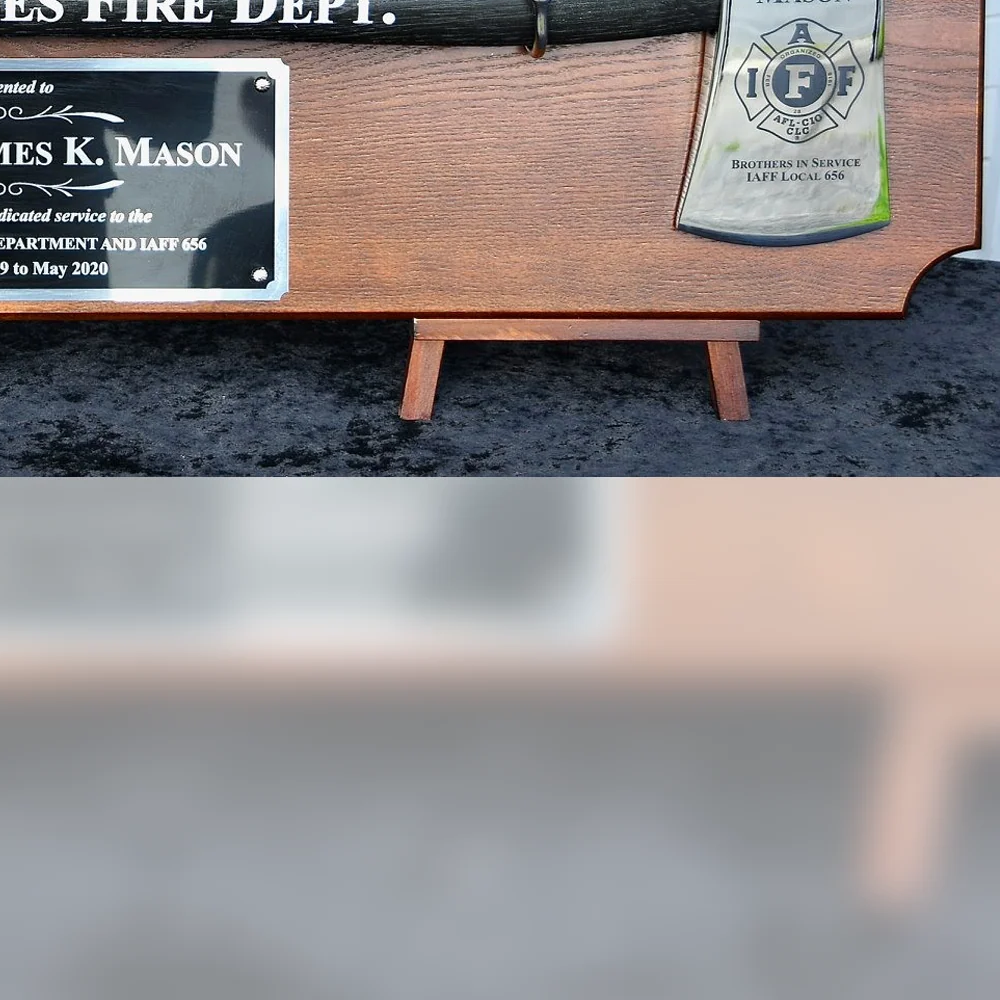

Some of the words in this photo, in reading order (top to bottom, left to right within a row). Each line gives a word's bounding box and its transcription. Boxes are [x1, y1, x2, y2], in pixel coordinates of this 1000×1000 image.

[780, 48, 822, 60] ORGANIZED
[38, 80, 55, 95] to
[773, 114, 823, 127] AFL-CIO
[786, 127, 810, 135] CLC
[63, 136, 104, 167] K.
[114, 137, 243, 167] MASON
[731, 159, 793, 169] BROTHERS
[796, 159, 808, 168] IN
[811, 158, 861, 168] SERVICE
[747, 172, 778, 182] IAFF
[780, 172, 821, 182] LOCAL
[824, 170, 845, 180] 656
[53, 209, 107, 223] service
[109, 211, 125, 223] to
[128, 208, 153, 223] the
[100, 237, 137, 251] AND
[139, 237, 180, 251] IAFF
[181, 237, 207, 251] 656
[13, 262, 29, 276] to
[32, 261, 68, 279] May
[71, 261, 109, 276] 2020
